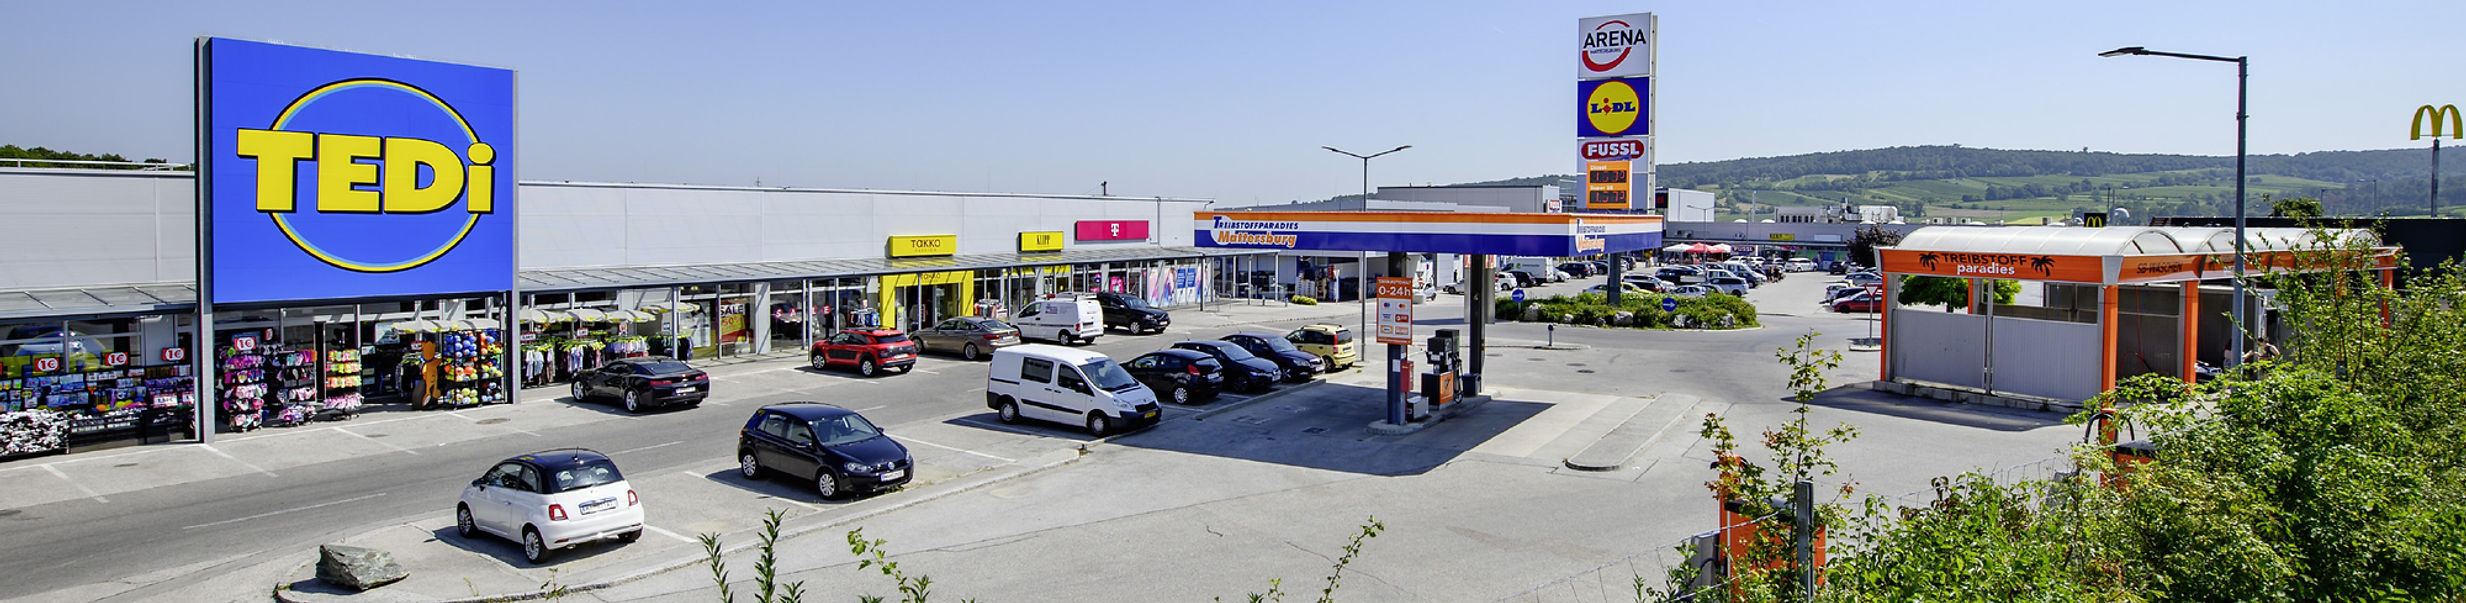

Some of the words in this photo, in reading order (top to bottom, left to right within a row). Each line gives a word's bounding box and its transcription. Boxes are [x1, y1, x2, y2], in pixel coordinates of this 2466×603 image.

[1583, 29, 1646, 48] ARENA
[1587, 143, 1640, 156] FUSSL
[1217, 230, 1296, 247] Mattersburg
[1941, 253, 2026, 265] TREIBSTOFF
[1957, 262, 2015, 275] paradies
